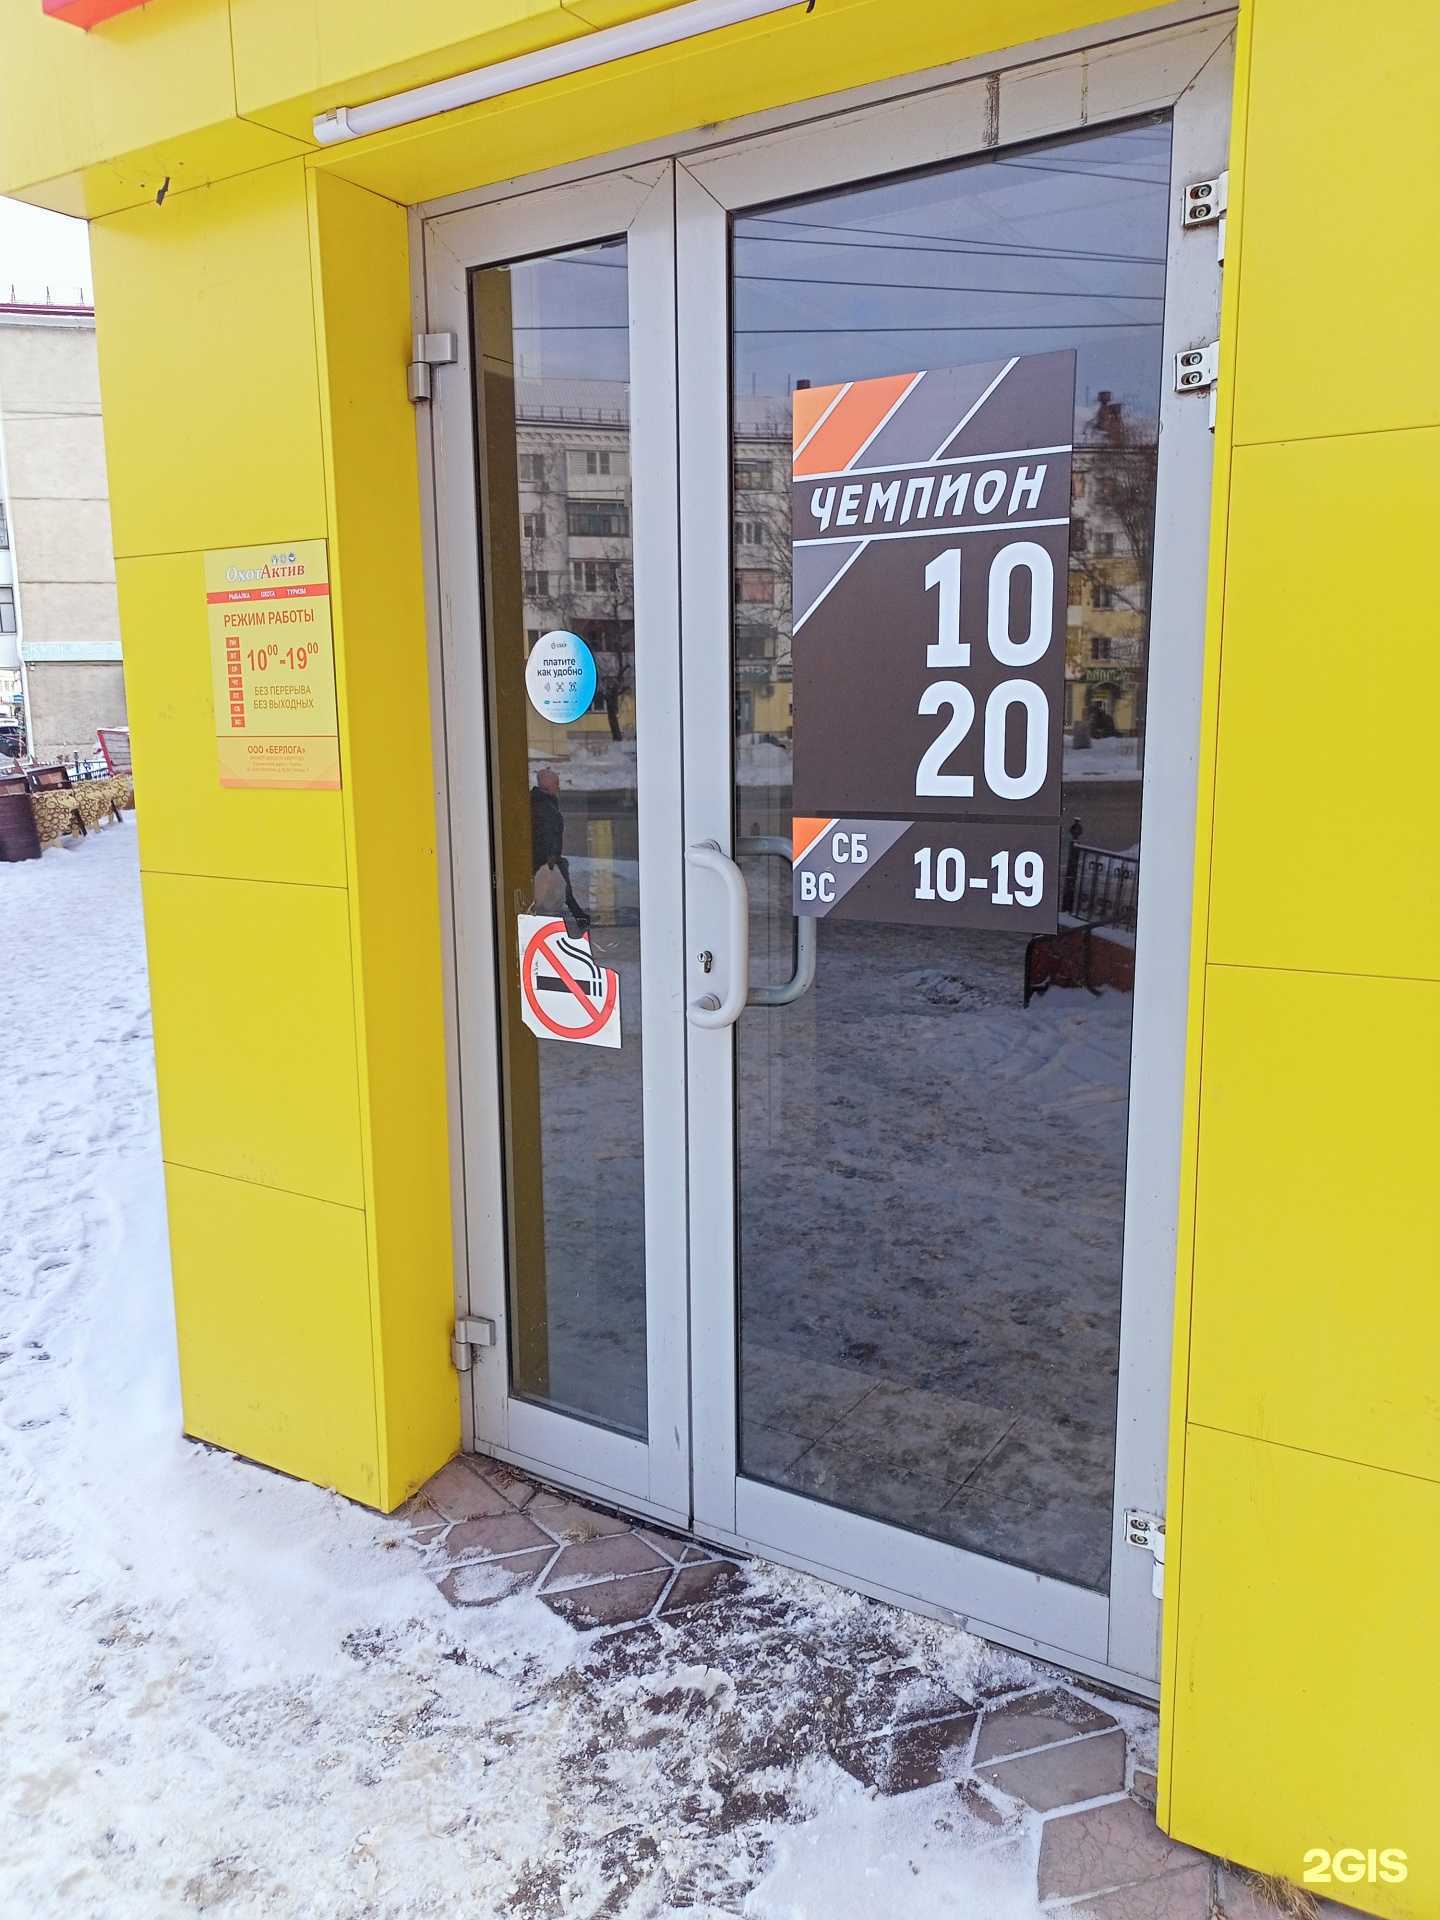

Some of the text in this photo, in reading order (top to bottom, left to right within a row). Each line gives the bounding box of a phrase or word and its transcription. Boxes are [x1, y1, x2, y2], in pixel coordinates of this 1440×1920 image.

[810, 464, 1048, 533] ЧЕМПИОН
[224, 608, 315, 628] РЕЖИМ РАБОТЫ
[924, 541, 1054, 669] 10
[537, 666, 583, 678] как удобно
[543, 657, 576, 667] платите
[254, 685, 312, 696] БЕЗ ПЕРЕРЫВА
[253, 700, 269, 710] БЕЗ
[269, 699, 314, 710] ВЫХОДНЫХ
[247, 745, 264, 754] ООО
[915, 678, 1050, 800] 20
[831, 832, 869, 864] СБ
[800, 871, 836, 903] ВС
[914, 847, 1044, 907] 10-19
